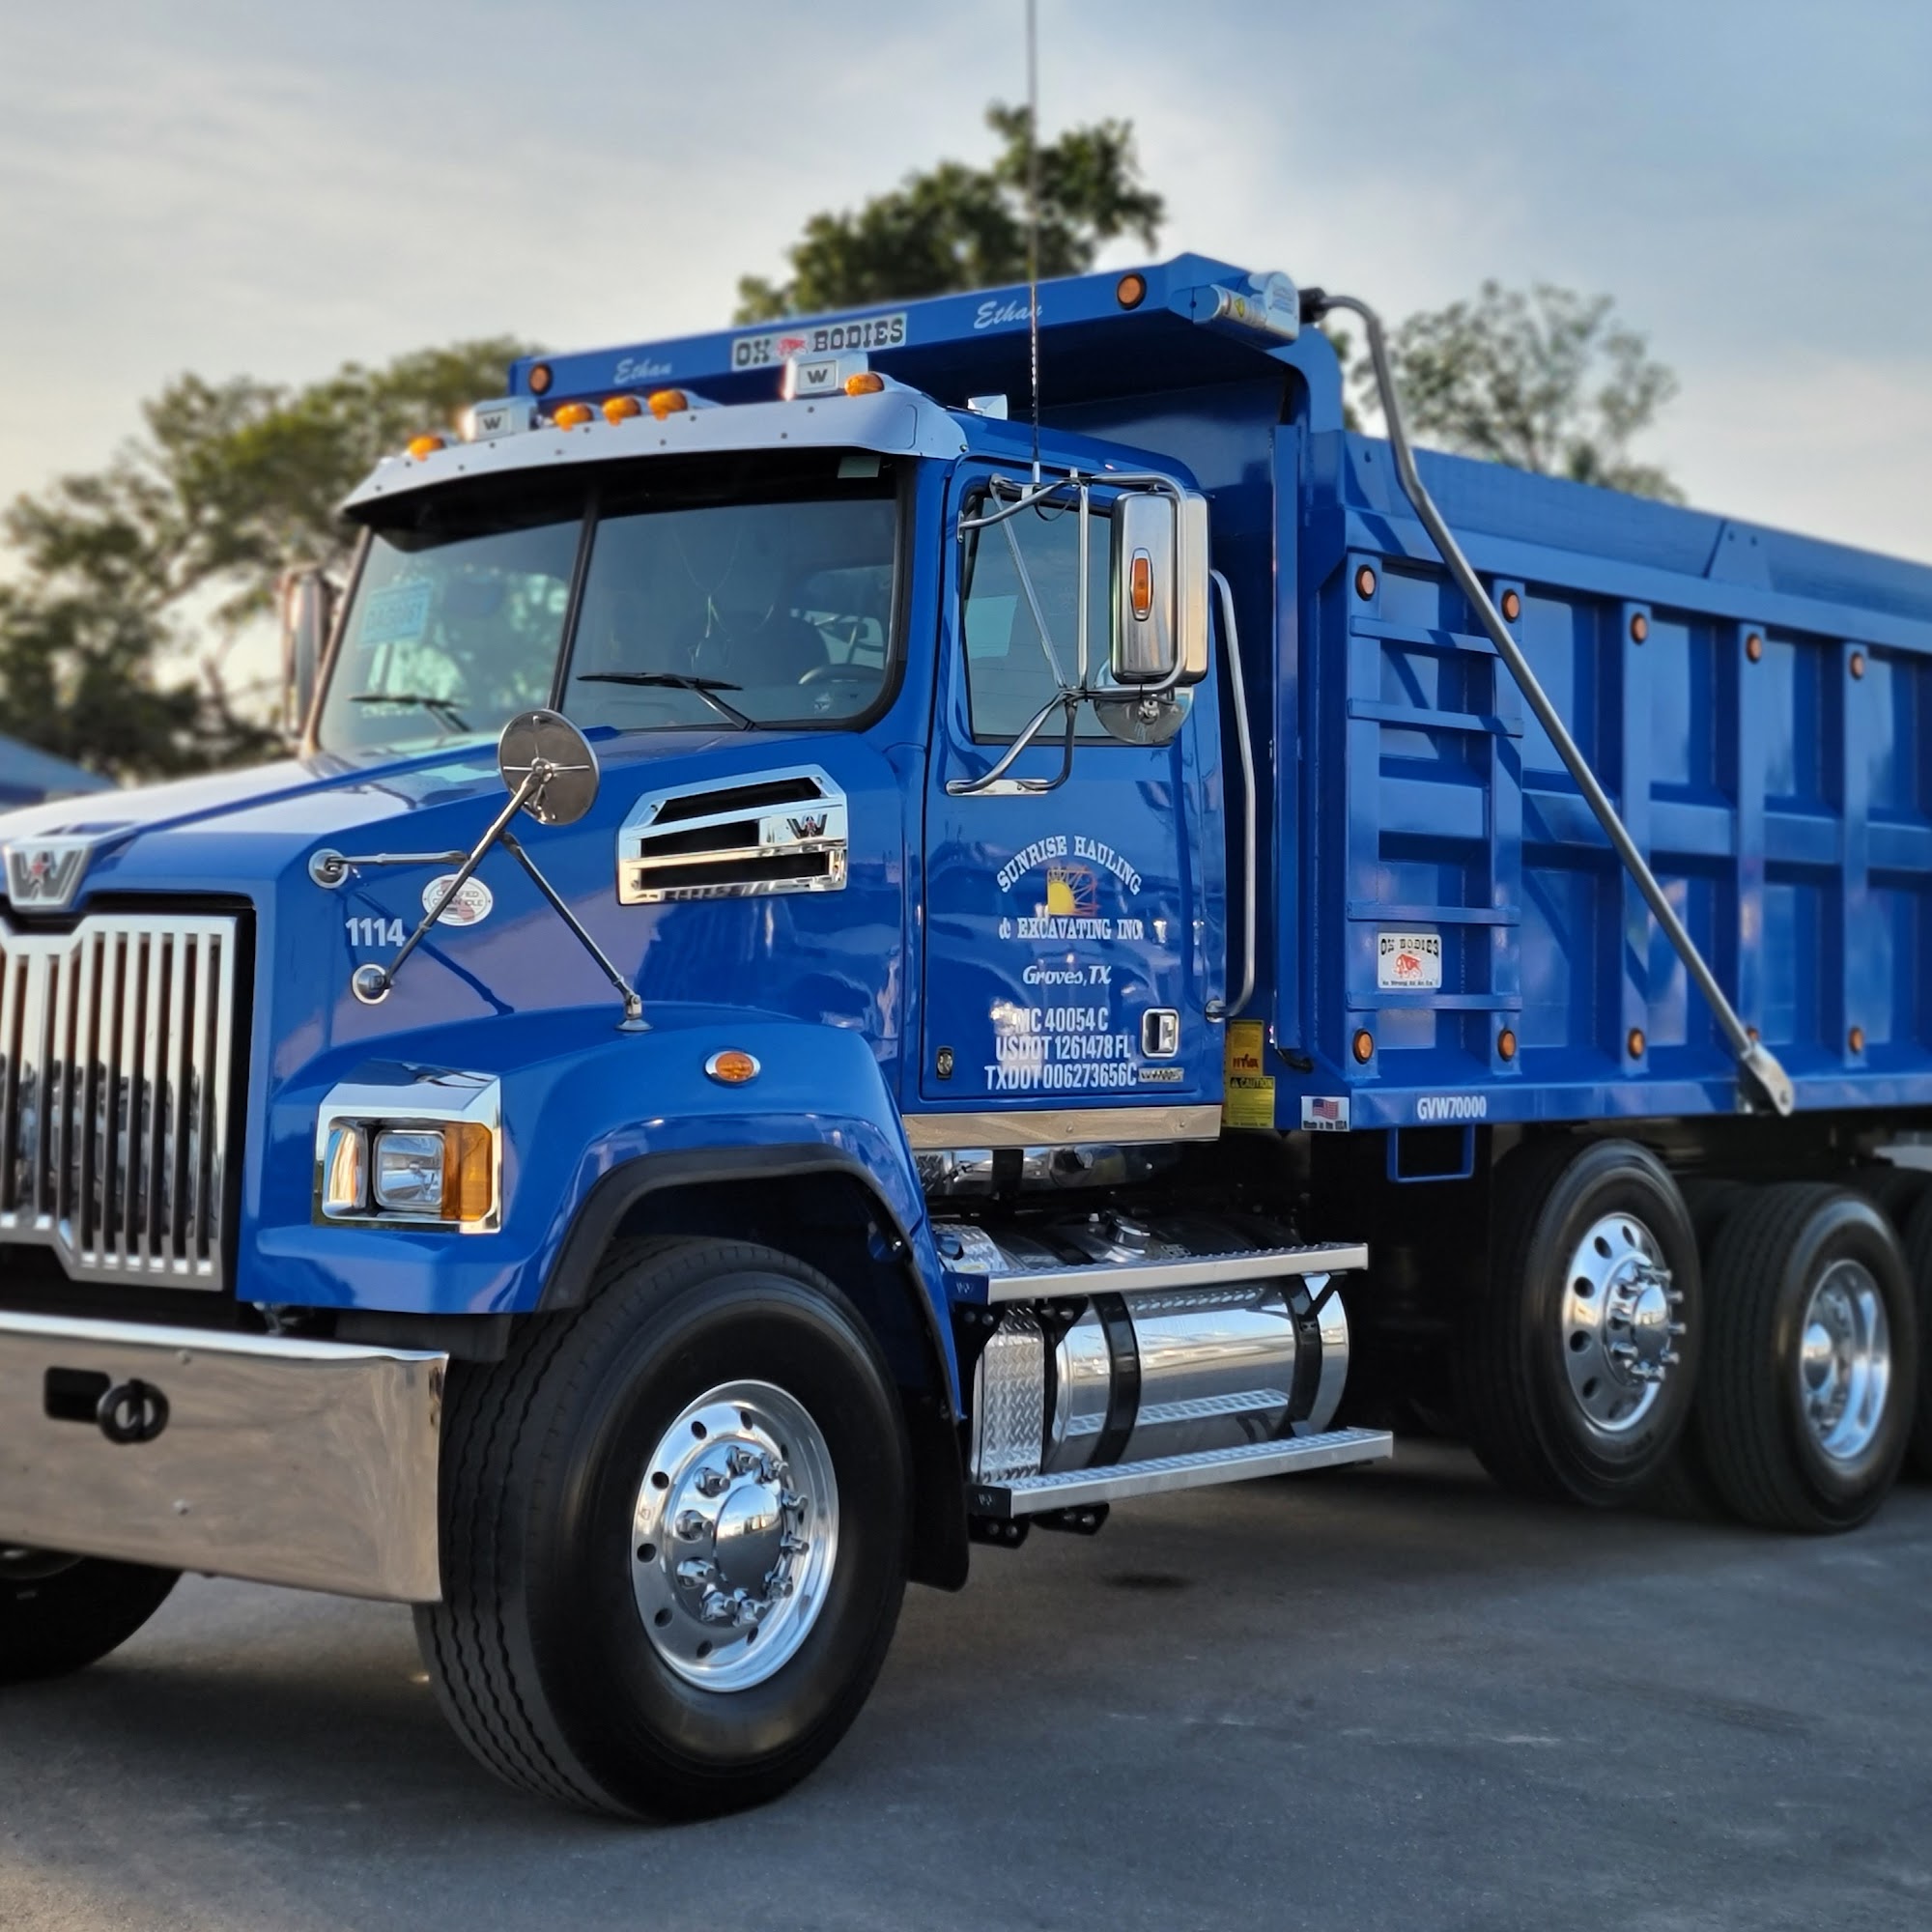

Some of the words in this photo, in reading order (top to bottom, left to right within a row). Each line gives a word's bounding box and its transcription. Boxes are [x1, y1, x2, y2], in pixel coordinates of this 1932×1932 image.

[735, 339, 771, 367] OX
[812, 317, 904, 354] BODIES
[613, 355, 673, 384] Ethan
[996, 835, 1067, 893] SUNRISE
[1073, 836, 1142, 895] HAULING
[345, 917, 406, 947] 1114
[1017, 918, 1111, 940] EXCAVATING
[1400, 938, 1439, 958] BODIES
[1015, 1008, 1042, 1033] MC
[1044, 1008, 1096, 1033] 40054
[996, 1037, 1052, 1061] USDOT
[1054, 1035, 1113, 1060] 1261478
[1115, 1035, 1131, 1059] FL
[984, 1065, 1043, 1091] TXDOT
[1042, 1063, 1138, 1089] 006273656C
[1417, 1095, 1487, 1120] GVW70000
